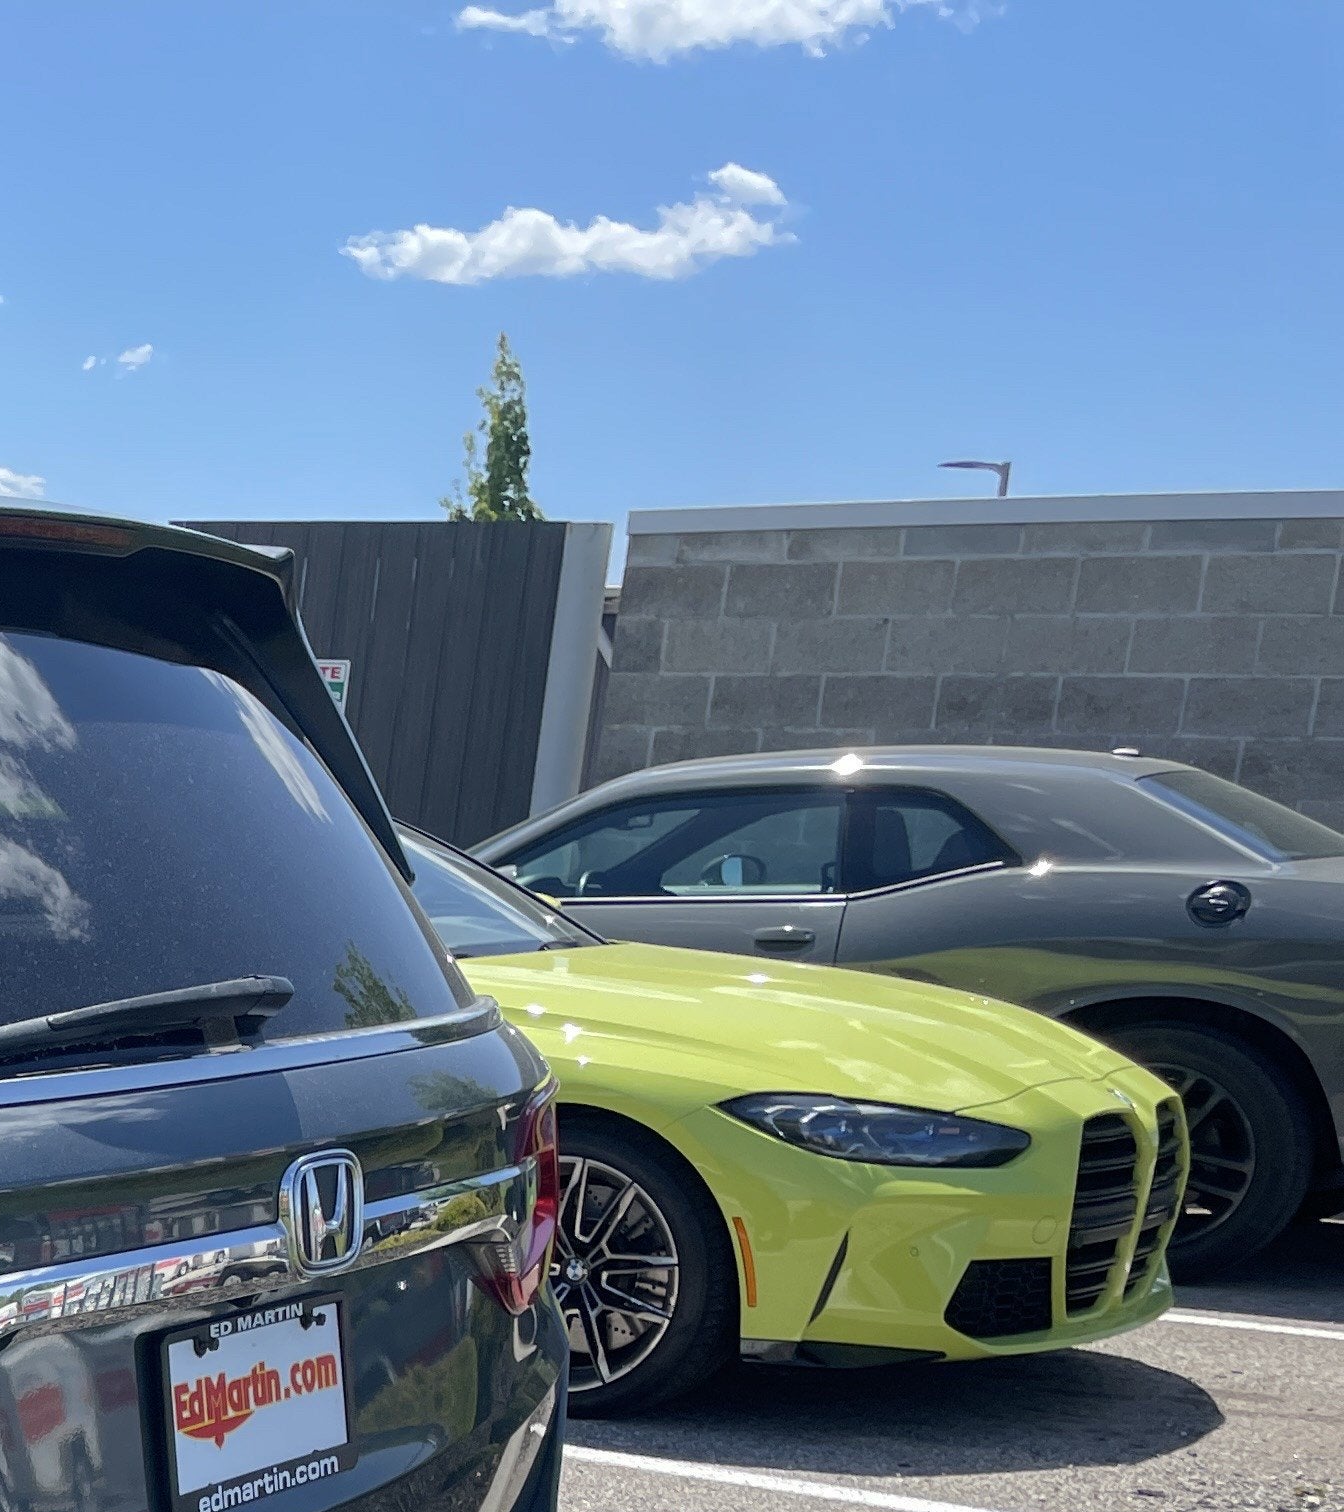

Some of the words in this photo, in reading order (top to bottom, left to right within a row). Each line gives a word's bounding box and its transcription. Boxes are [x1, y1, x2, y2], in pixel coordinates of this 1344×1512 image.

[209, 1321, 232, 1338] ED
[237, 1302, 304, 1331] MARTIN
[173, 1351, 339, 1436] EdMartin.com
